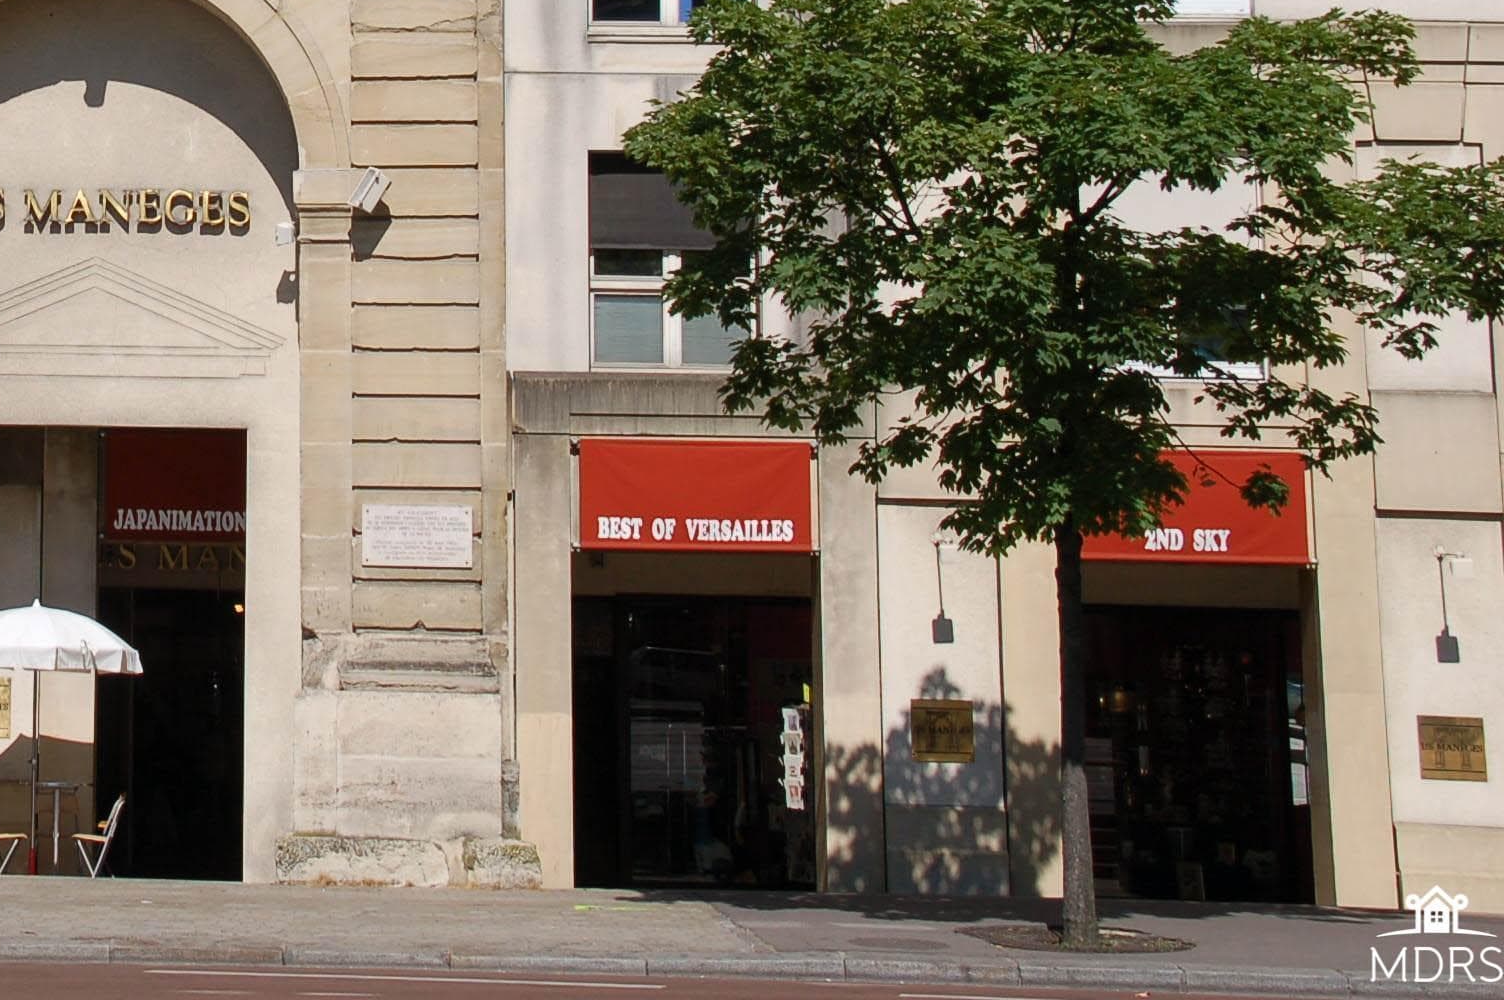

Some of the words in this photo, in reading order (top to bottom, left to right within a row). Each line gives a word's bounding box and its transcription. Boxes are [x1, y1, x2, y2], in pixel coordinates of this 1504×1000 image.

[23, 188, 251, 226] MANEGES
[113, 508, 245, 532] JAPANIMATION
[597, 516, 643, 540] BEST
[651, 517, 676, 540] OF
[685, 519, 794, 542] VERSAILLES
[1144, 528, 1184, 551] 2ND
[1193, 528, 1230, 552] SKY
